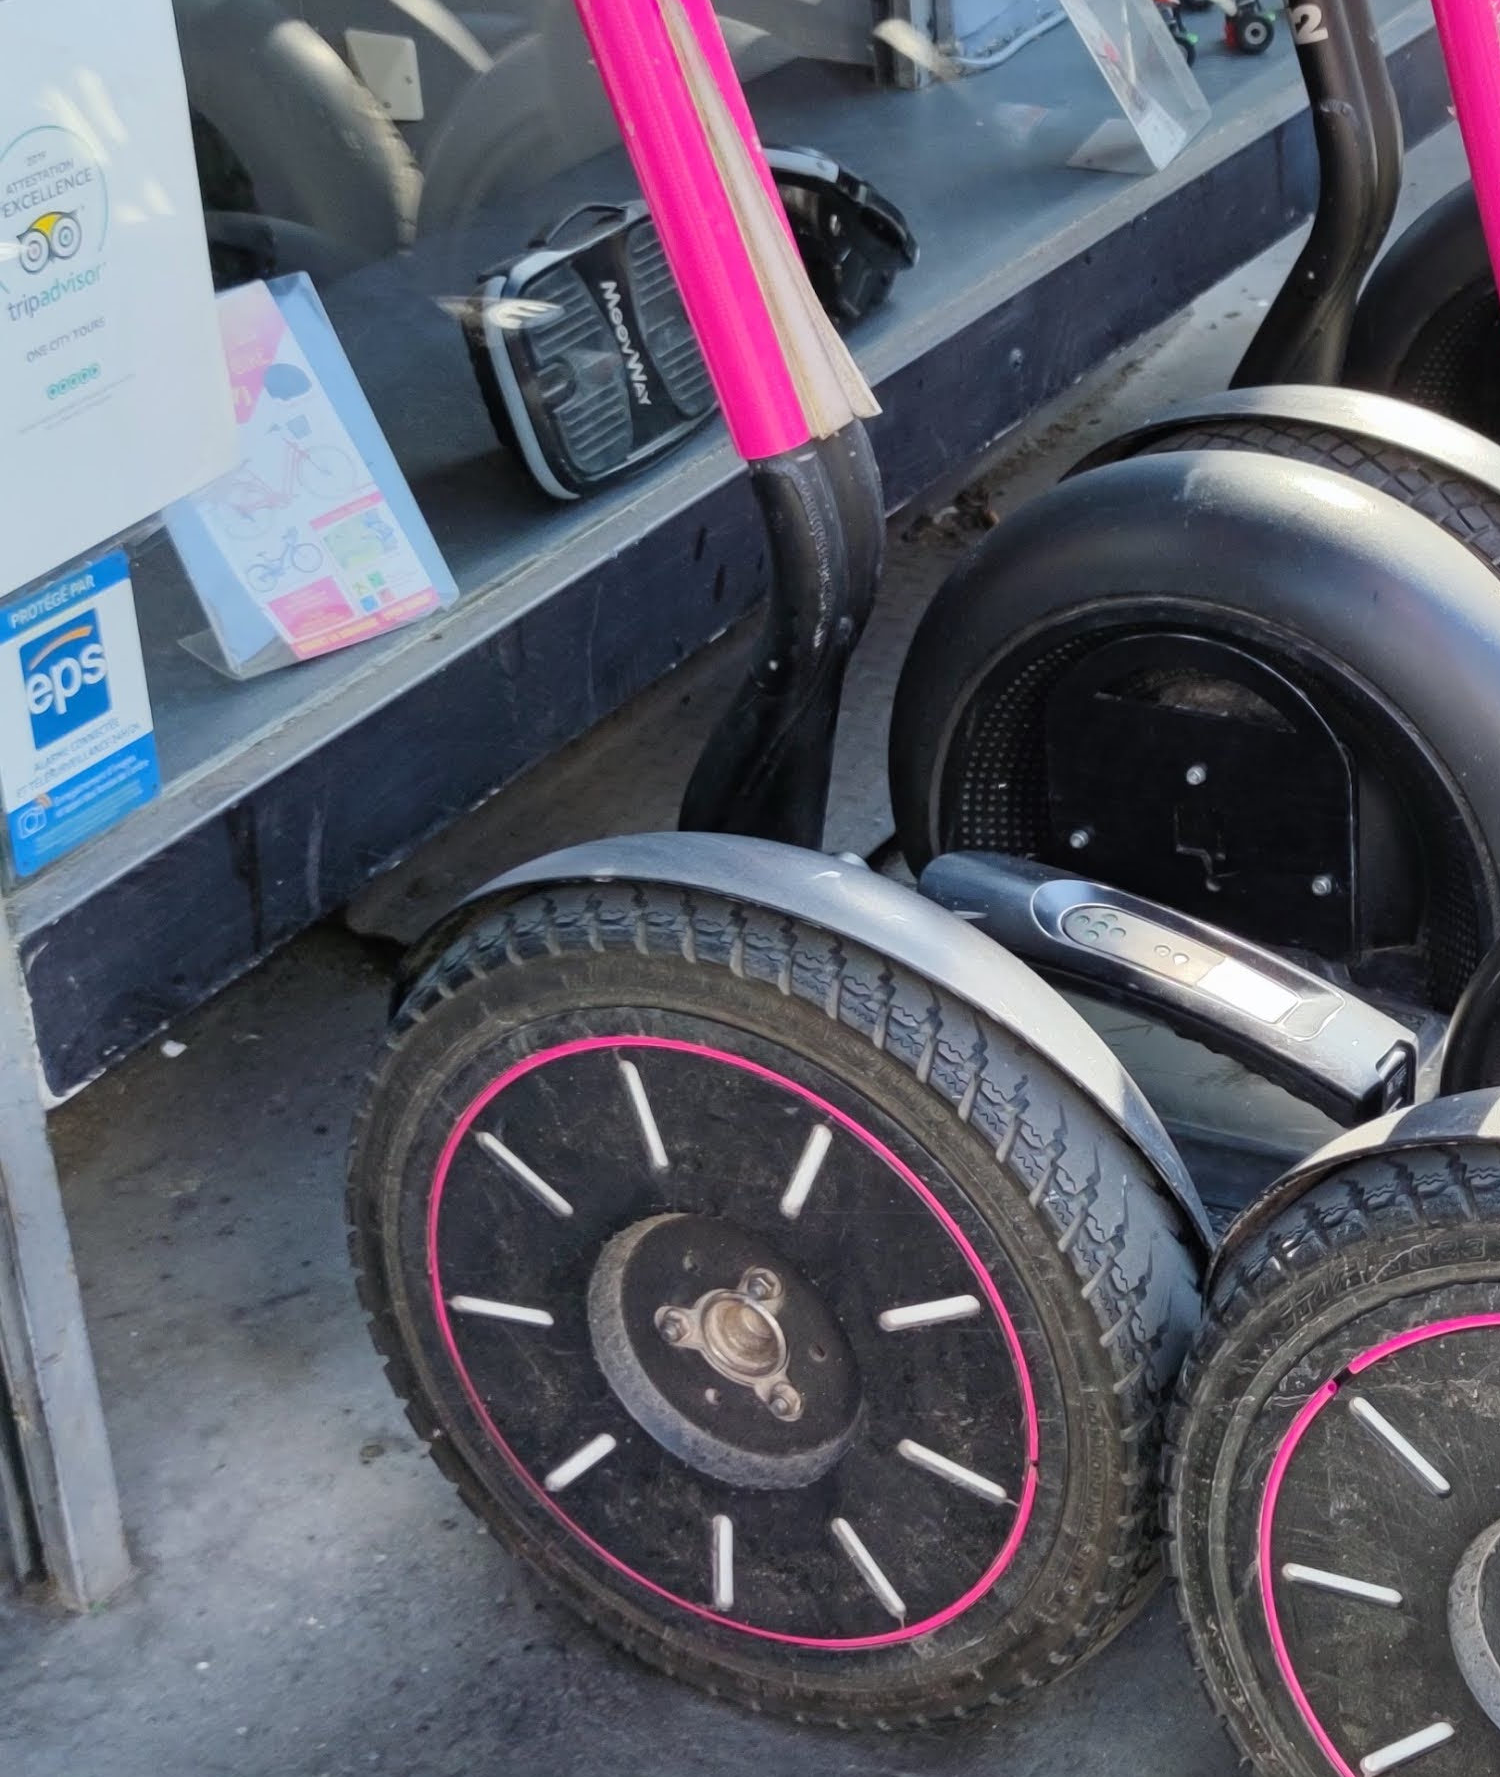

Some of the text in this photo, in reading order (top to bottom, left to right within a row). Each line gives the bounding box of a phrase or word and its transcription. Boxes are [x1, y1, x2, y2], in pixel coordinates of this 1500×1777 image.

[8, 264, 103, 322] tripadvisor
[70, 574, 96, 597] PAR
[26, 642, 109, 715] eps
